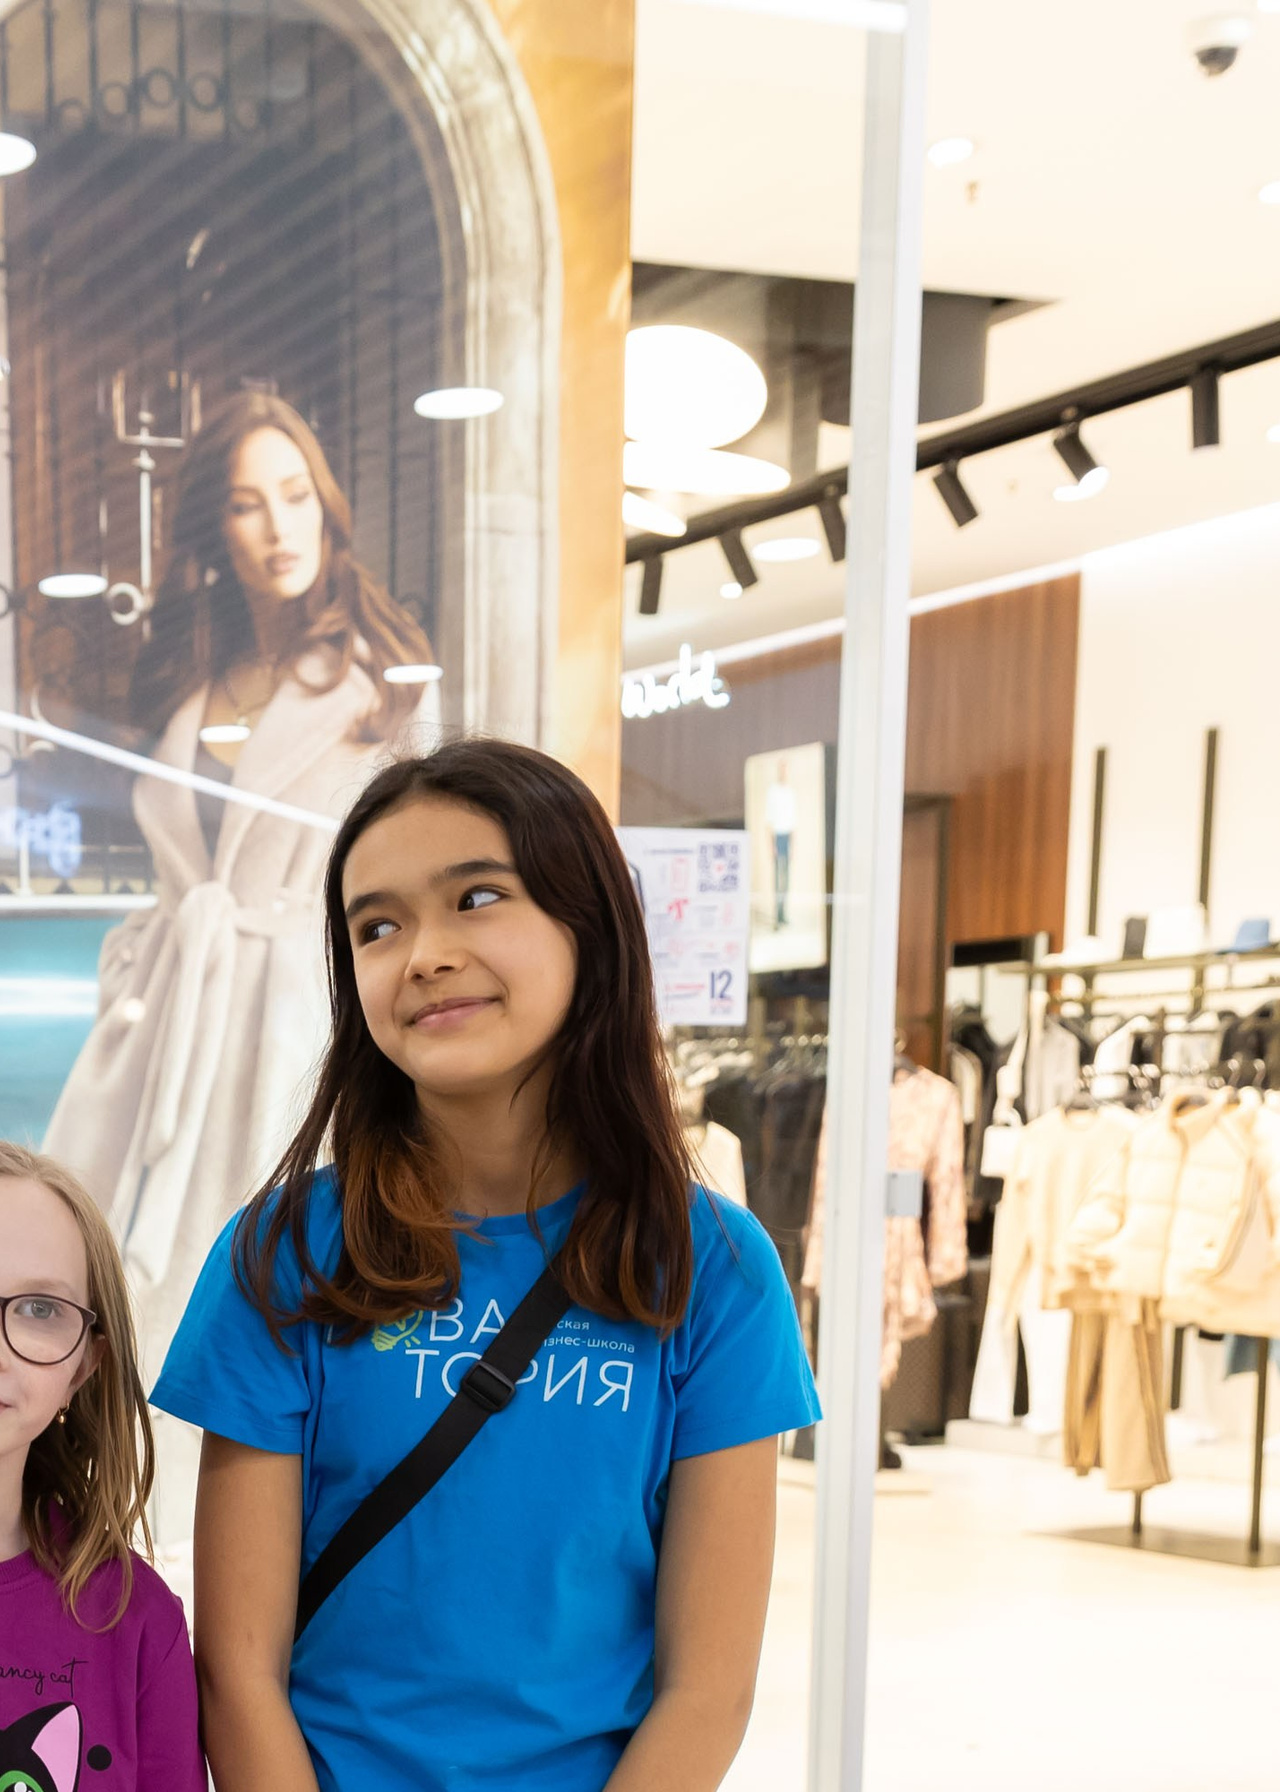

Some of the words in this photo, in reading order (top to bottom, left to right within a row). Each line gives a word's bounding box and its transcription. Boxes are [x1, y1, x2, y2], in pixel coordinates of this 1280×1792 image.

[709, 968, 733, 1000] 12
[556, 1319, 591, 1331] ская
[543, 1335, 636, 1354] знес-школа
[49, 1656, 90, 1699] cat
